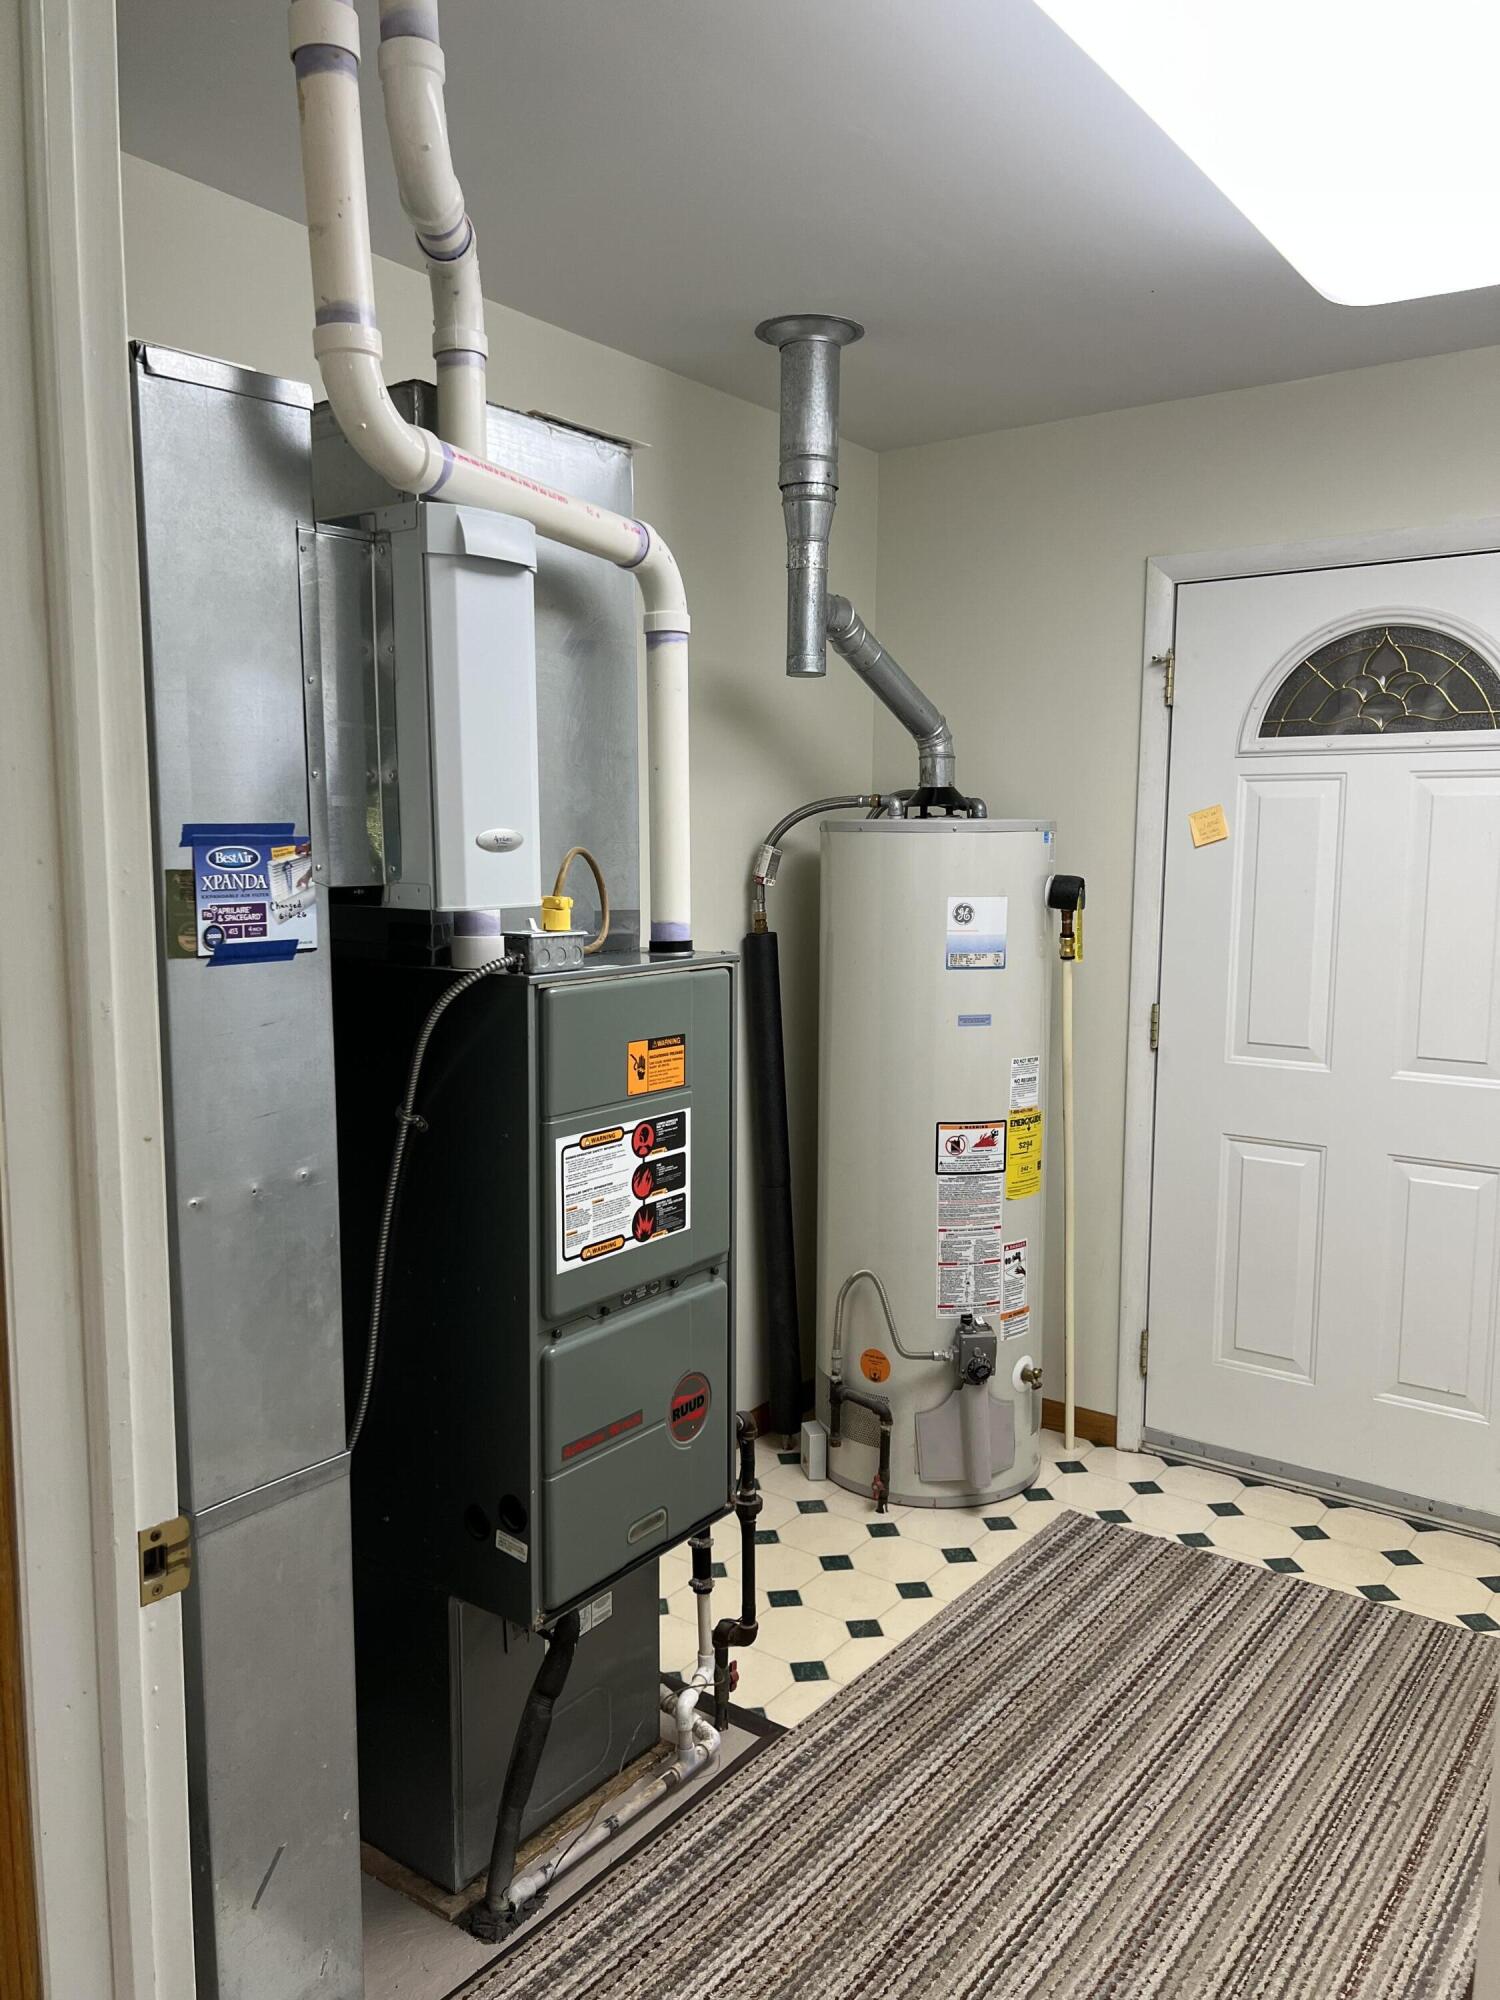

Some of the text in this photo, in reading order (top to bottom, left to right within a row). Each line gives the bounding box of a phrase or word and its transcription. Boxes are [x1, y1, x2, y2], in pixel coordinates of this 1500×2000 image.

[215, 851, 253, 864] BestAir
[201, 873, 269, 892] XPANDA
[270, 899, 302, 912] Changed
[956, 905, 973, 923] GE
[590, 1132, 616, 1144] WARNING
[591, 1240, 617, 1254] WARNING
[672, 1394, 705, 1422] RUUD
